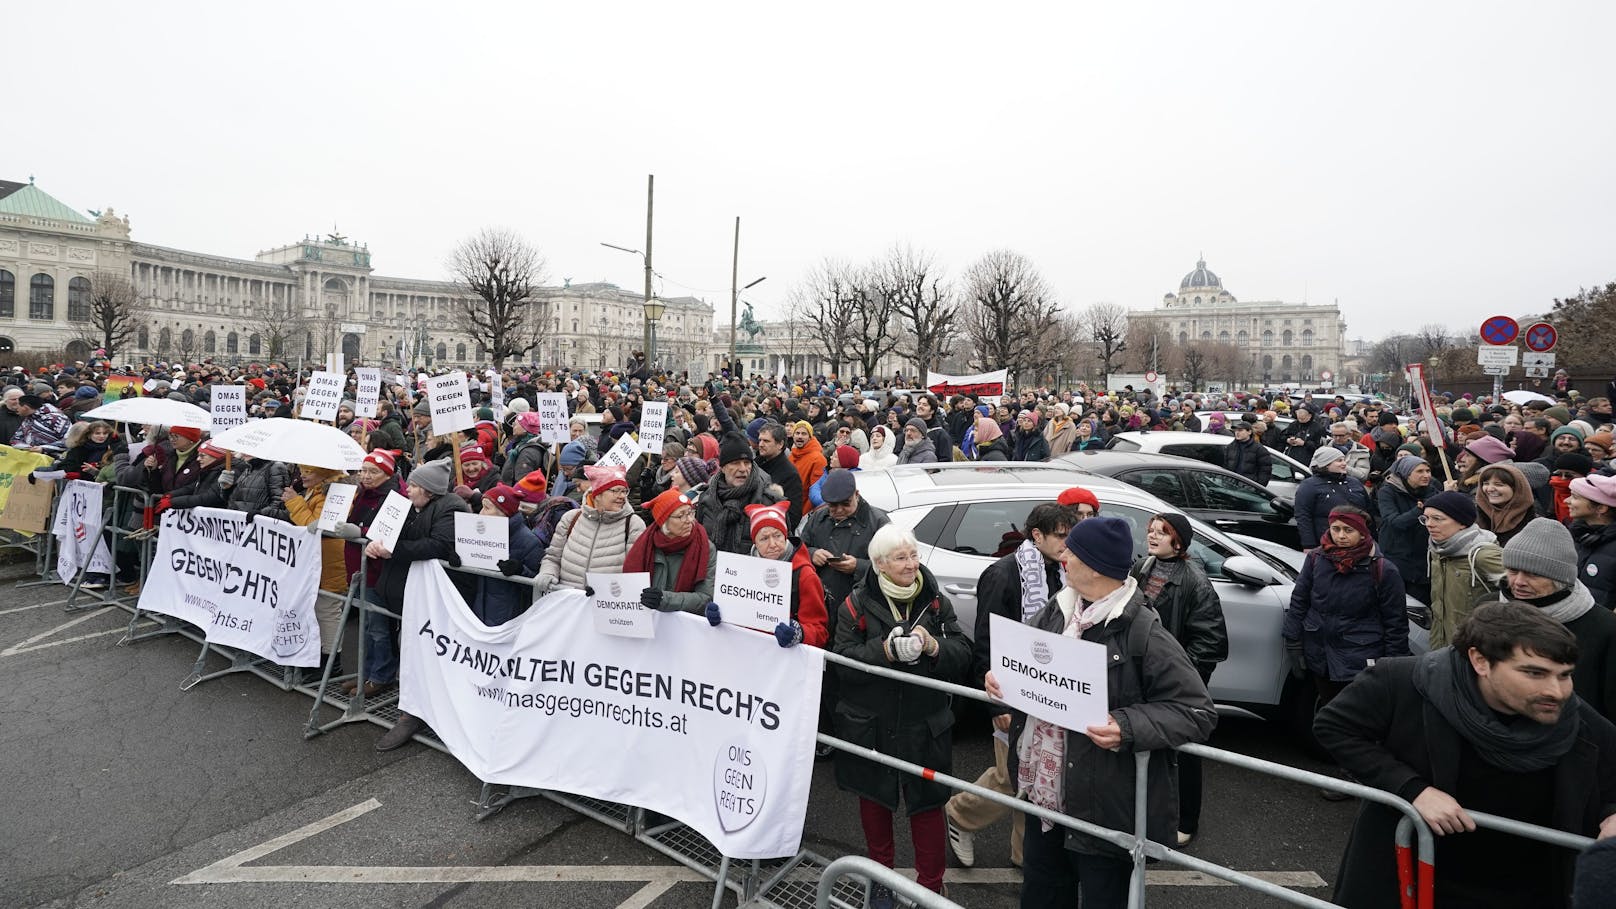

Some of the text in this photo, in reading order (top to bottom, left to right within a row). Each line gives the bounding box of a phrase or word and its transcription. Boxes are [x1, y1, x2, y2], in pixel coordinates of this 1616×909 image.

[316, 377, 339, 387] OMAS
[362, 373, 377, 381] OMAS
[360, 385, 377, 393] GEGEN
[436, 379, 460, 389] OMAS
[217, 392, 240, 400] OMAS
[311, 388, 338, 398] GEGEN
[436, 391, 463, 402] GEGEN
[306, 400, 337, 410] RECHTS
[357, 397, 377, 405] RECHTS
[543, 399, 559, 407] OMA
[215, 405, 242, 413] GEGEN
[436, 403, 467, 415] RECHTS
[646, 408, 663, 416] OMAS
[542, 411, 565, 419] GEGN
[541, 423, 568, 431] RECTS
[643, 420, 663, 428] GEGEN
[640, 432, 663, 441] RECHTS
[620, 442, 635, 459] OMAS
[457, 537, 506, 550] MENSCHENRECHTE
[470, 552, 493, 561] schützen
[171, 548, 222, 585] GEGEN
[725, 567, 738, 577] Aus
[720, 584, 783, 606] GESCHICHTE
[596, 600, 644, 611] DEMOKRATIE
[756, 611, 779, 623] lernen
[608, 618, 634, 627] schützen
[1002, 656, 1092, 695] DEMOKRATIE
[584, 663, 672, 700] GEGEN
[681, 679, 780, 731] RECHTS
[1020, 688, 1067, 711] schützen
